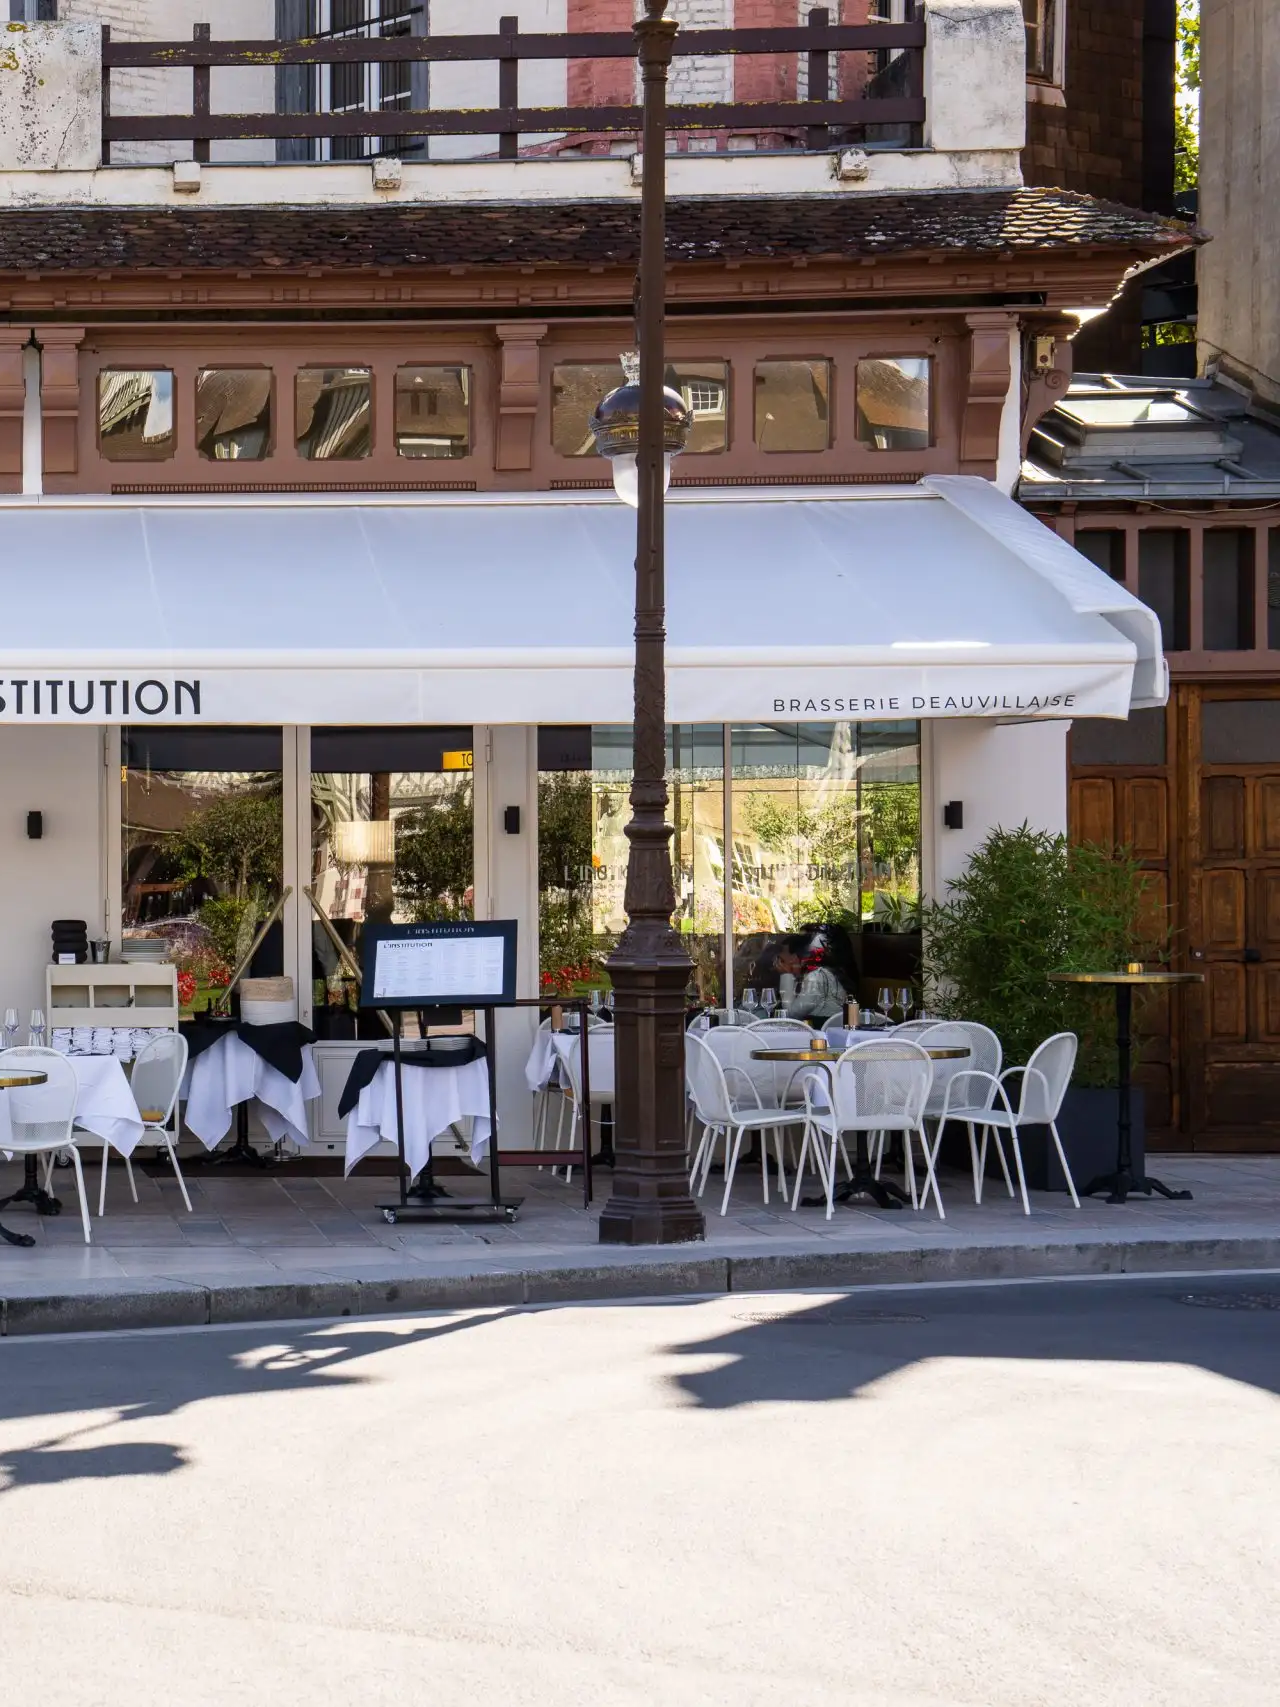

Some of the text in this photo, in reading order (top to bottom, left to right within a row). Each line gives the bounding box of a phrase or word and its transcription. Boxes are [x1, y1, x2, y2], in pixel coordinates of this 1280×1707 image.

[773, 694, 1076, 712] BRASSERIE DEAUVILLAISE
[383, 941, 433, 949] L'INSTITUTION
